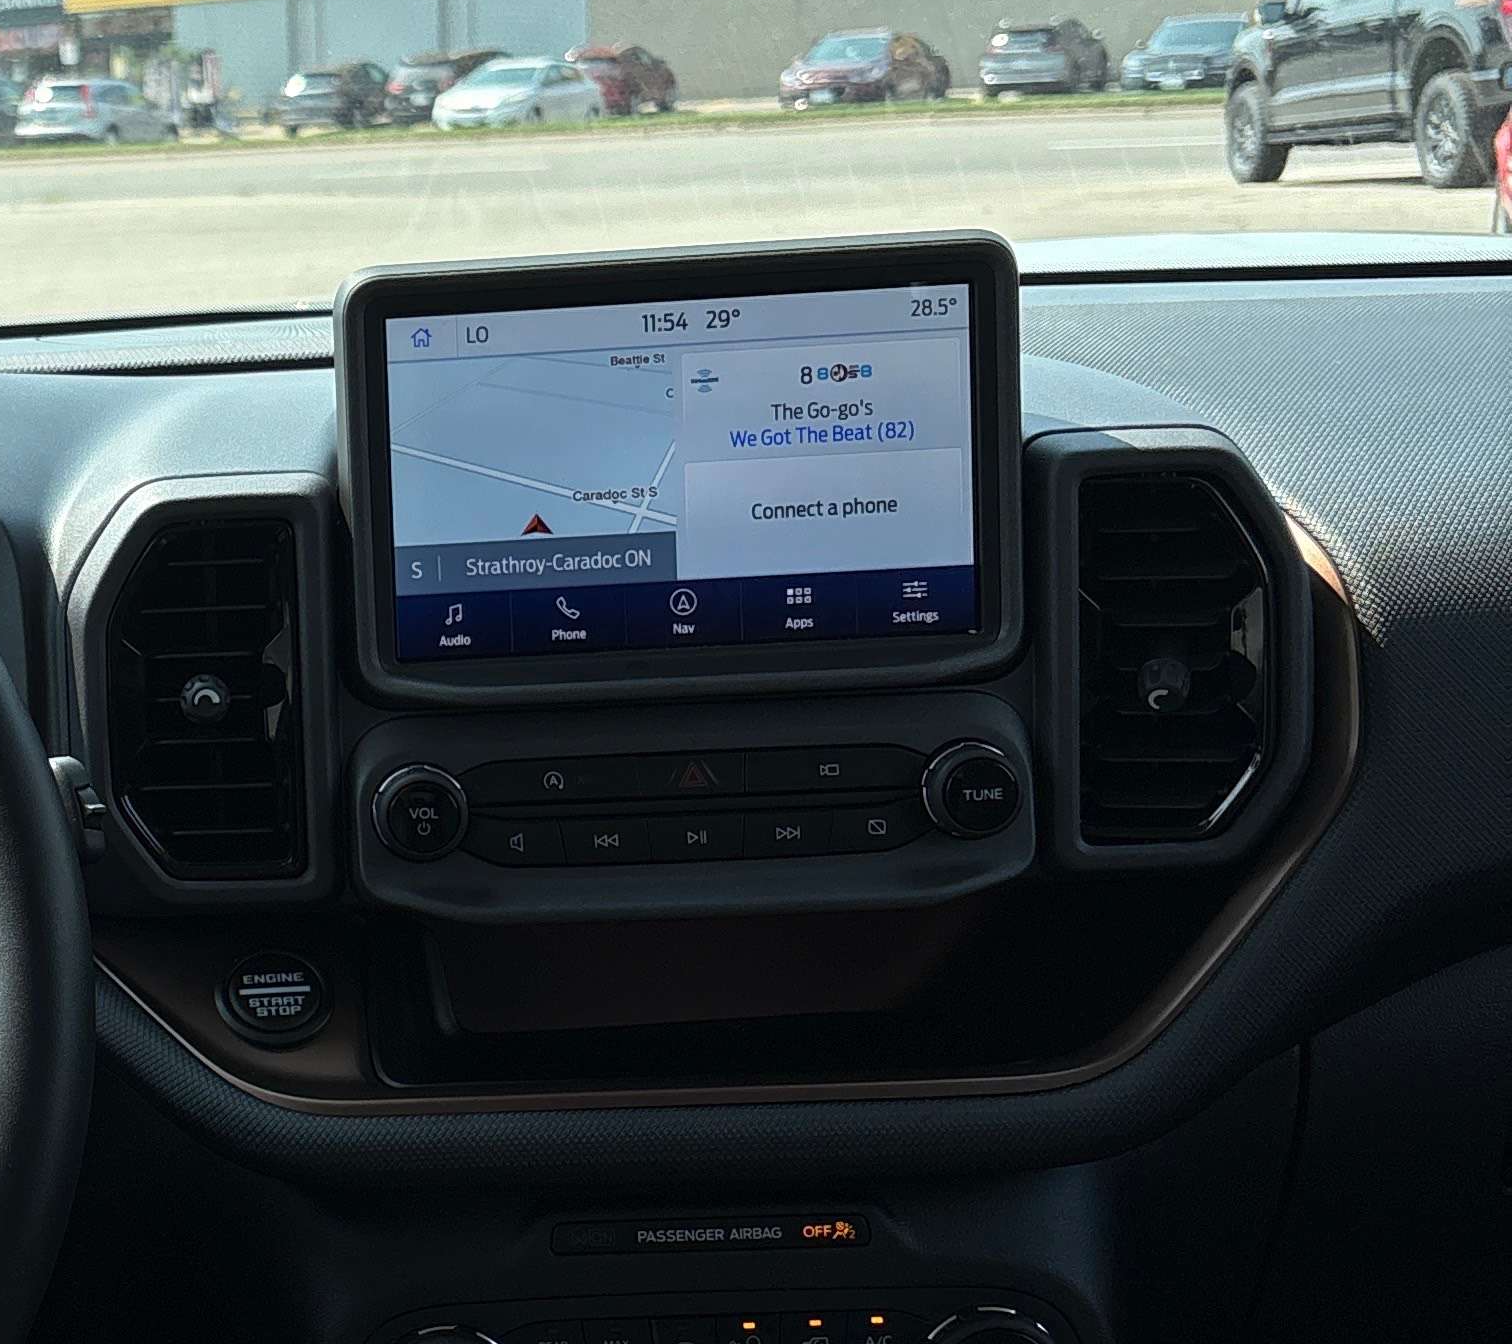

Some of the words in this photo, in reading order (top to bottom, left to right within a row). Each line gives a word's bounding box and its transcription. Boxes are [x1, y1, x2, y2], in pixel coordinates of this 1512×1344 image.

[464, 324, 489, 345] LO
[641, 311, 687, 333] 11:54
[705, 308, 741, 330] 29°
[910, 297, 958, 317] 28.5°
[652, 353, 665, 365] St
[800, 365, 813, 385] 8
[771, 402, 803, 421] The
[806, 398, 873, 424] Go-go's
[729, 428, 756, 448] We
[760, 426, 791, 447] Got
[794, 425, 827, 445] The
[831, 423, 872, 443] Beat
[876, 420, 915, 444] (82)
[572, 489, 626, 504] Caradoc
[629, 487, 644, 500] St
[751, 500, 823, 521] Connect
[826, 503, 838, 517] a
[841, 496, 898, 522] phone
[410, 561, 422, 579] S
[464, 552, 622, 578] Strathroy-Caradoc
[624, 549, 651, 567] ON
[784, 617, 814, 632] Apps
[891, 609, 940, 626] Settings
[550, 628, 587, 641] Phone
[672, 622, 695, 634] Nav
[438, 634, 471, 647] Audio
[962, 786, 1004, 804] TUNE
[408, 806, 439, 822] VOL
[242, 971, 304, 985] ENGINE
[248, 994, 306, 1009] START
[255, 1004, 302, 1018] STOP
[636, 1226, 724, 1245] PASSENGER
[729, 1224, 782, 1242] AIRBAG
[801, 1223, 832, 1239] OFF
